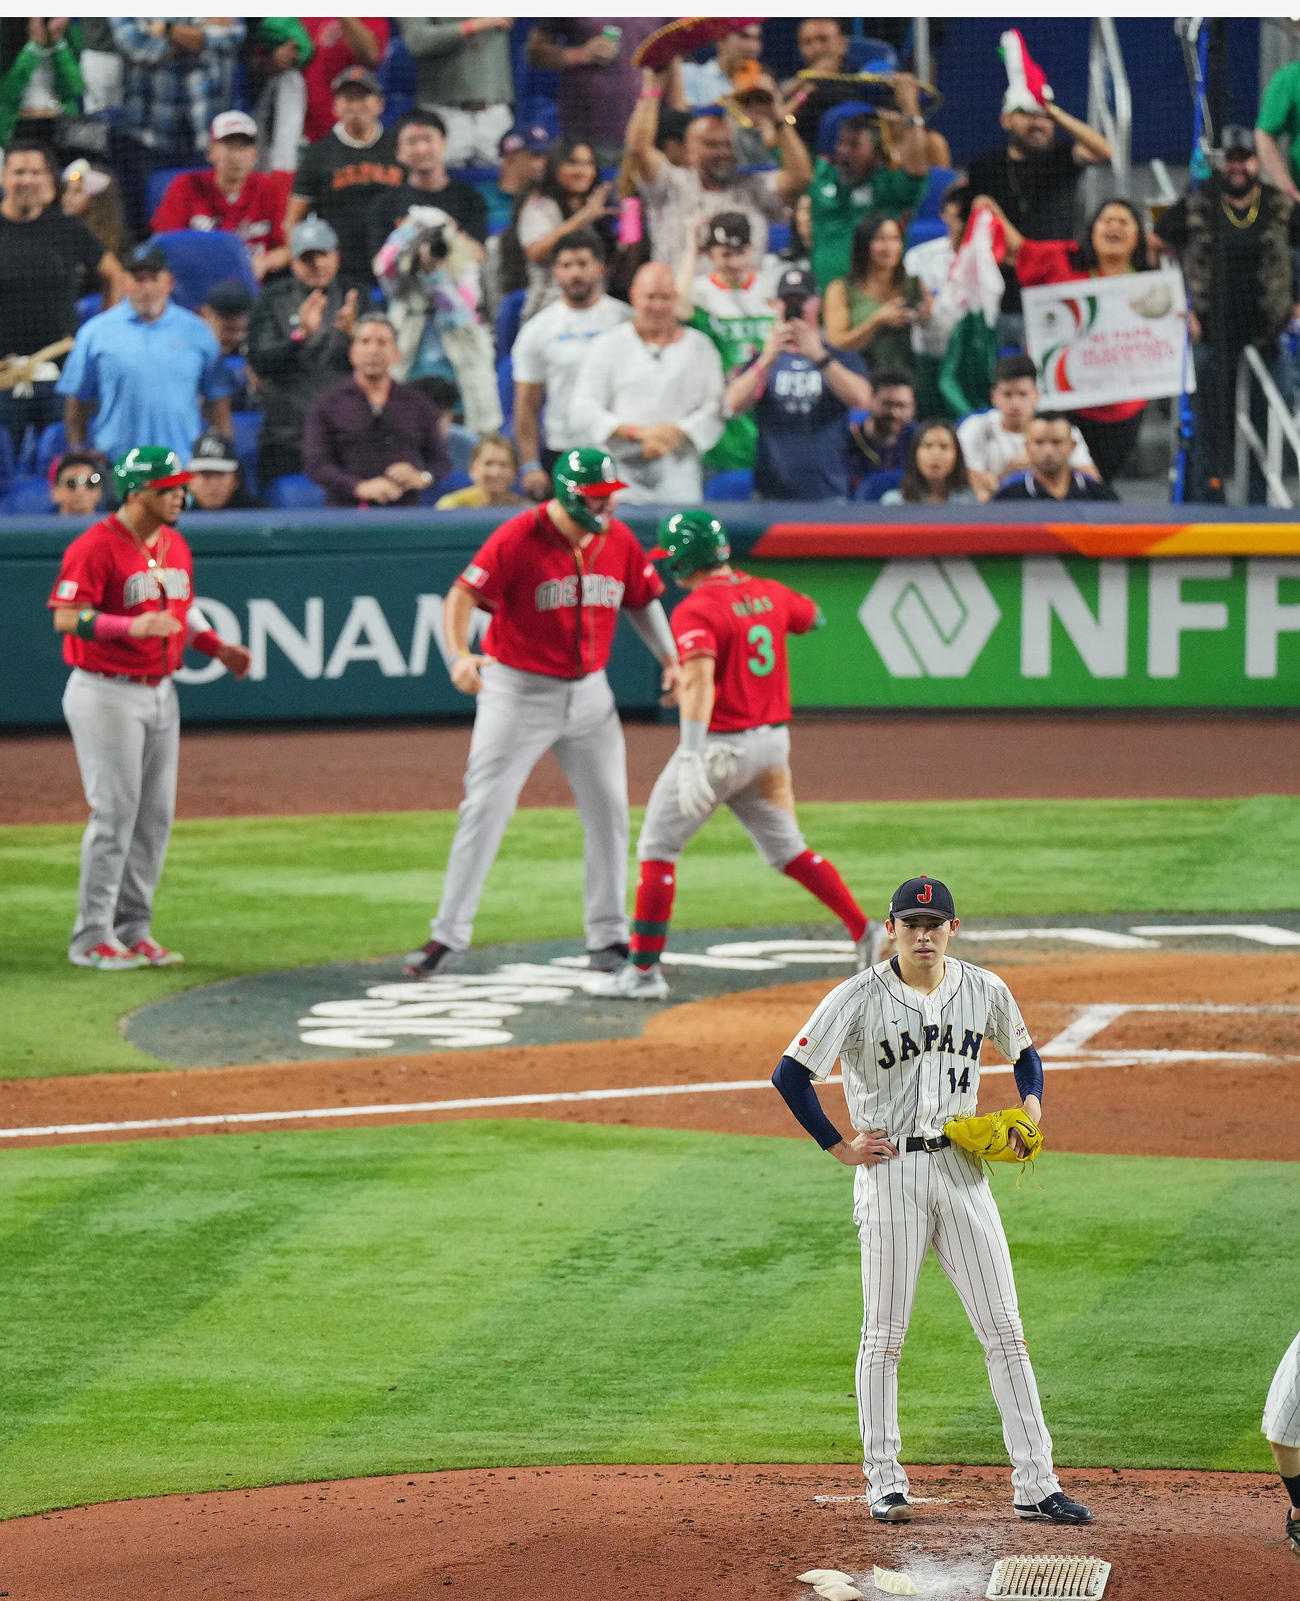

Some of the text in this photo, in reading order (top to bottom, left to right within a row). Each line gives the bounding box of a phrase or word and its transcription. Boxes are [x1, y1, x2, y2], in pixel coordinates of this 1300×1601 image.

[775, 369, 823, 398] USA
[747, 625, 776, 677] 3
[916, 884, 934, 904] J
[877, 1023, 985, 1071] JAPAN
[947, 1067, 971, 1094] 14
